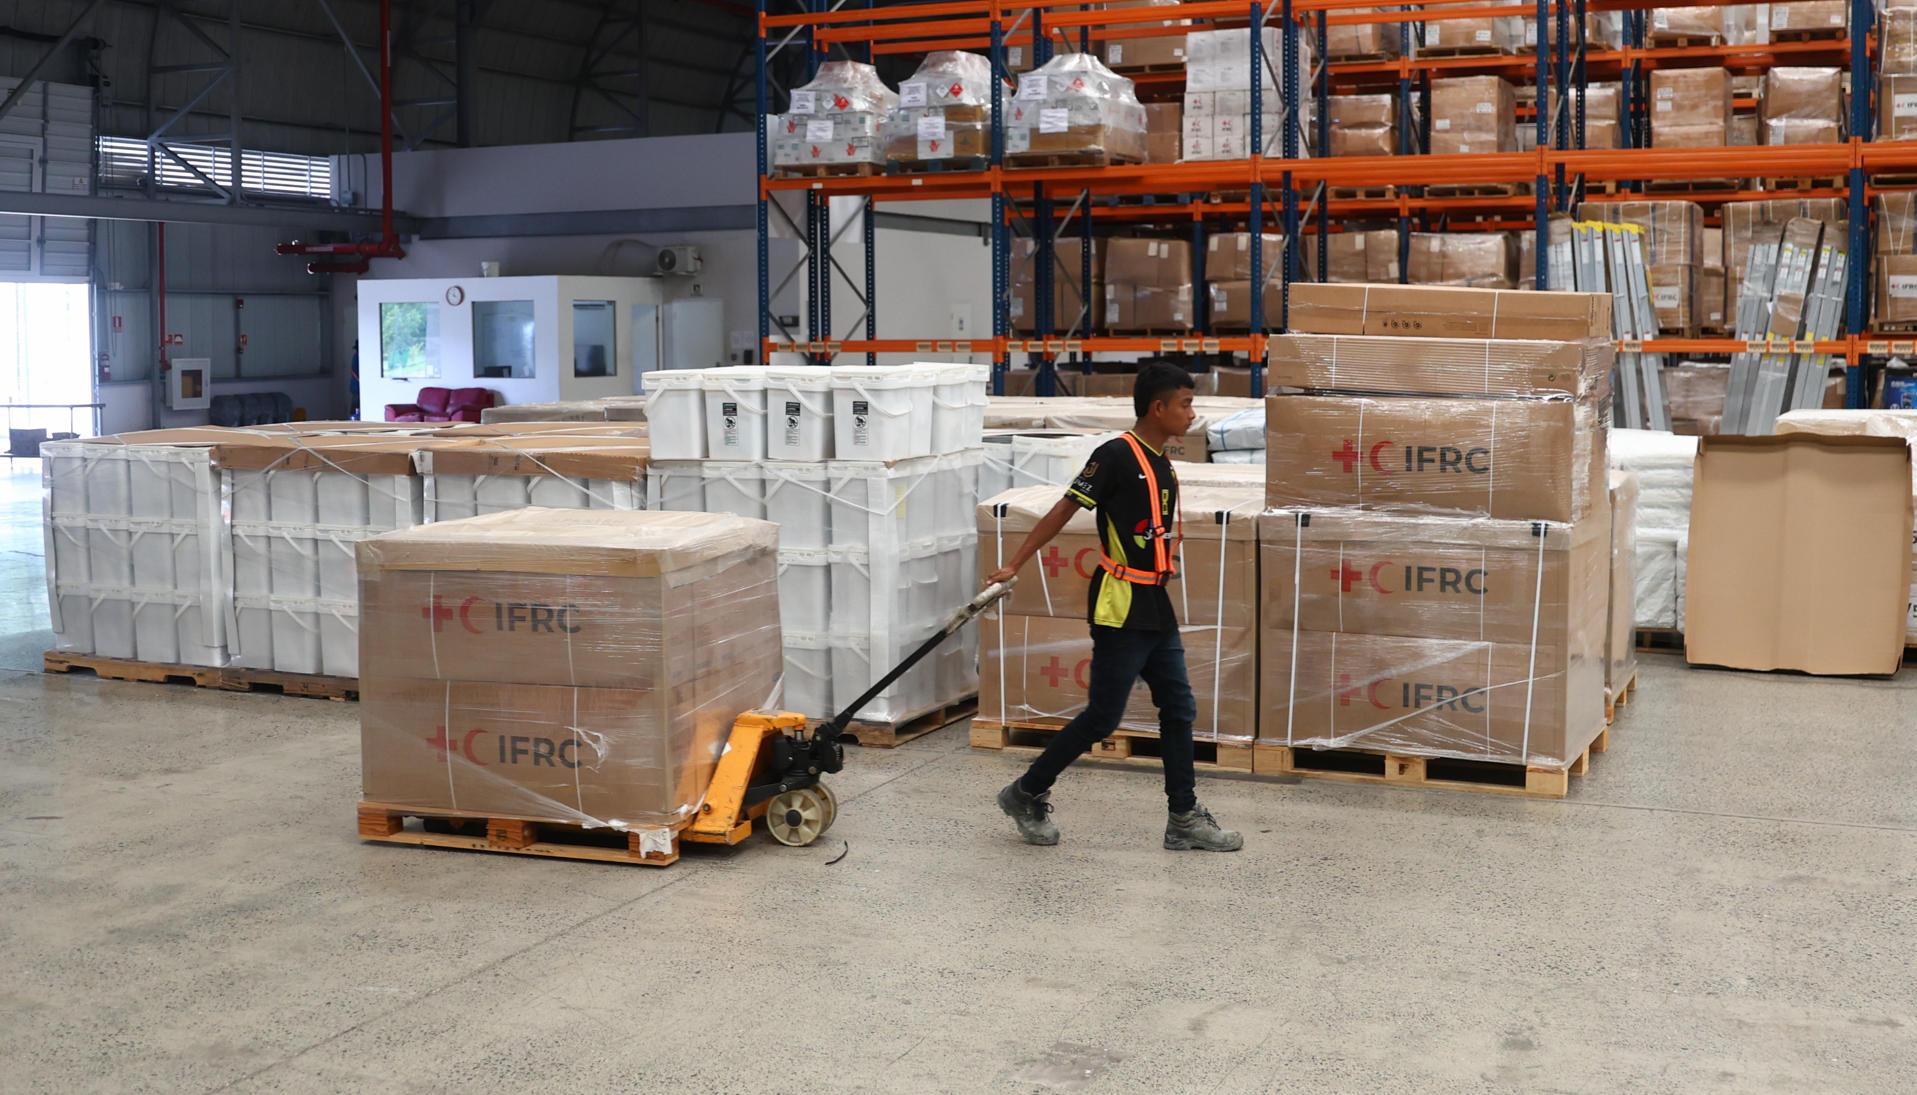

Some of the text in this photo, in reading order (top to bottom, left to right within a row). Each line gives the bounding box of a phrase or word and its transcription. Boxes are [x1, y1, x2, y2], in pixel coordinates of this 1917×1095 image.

[1163, 445, 1185, 456] FRC
[1405, 445, 1490, 474] IFRC
[1404, 565, 1489, 595] IFRC
[495, 602, 582, 634] IFRC
[1402, 682, 1486, 714] IFRC
[498, 735, 583, 769] IFRC
